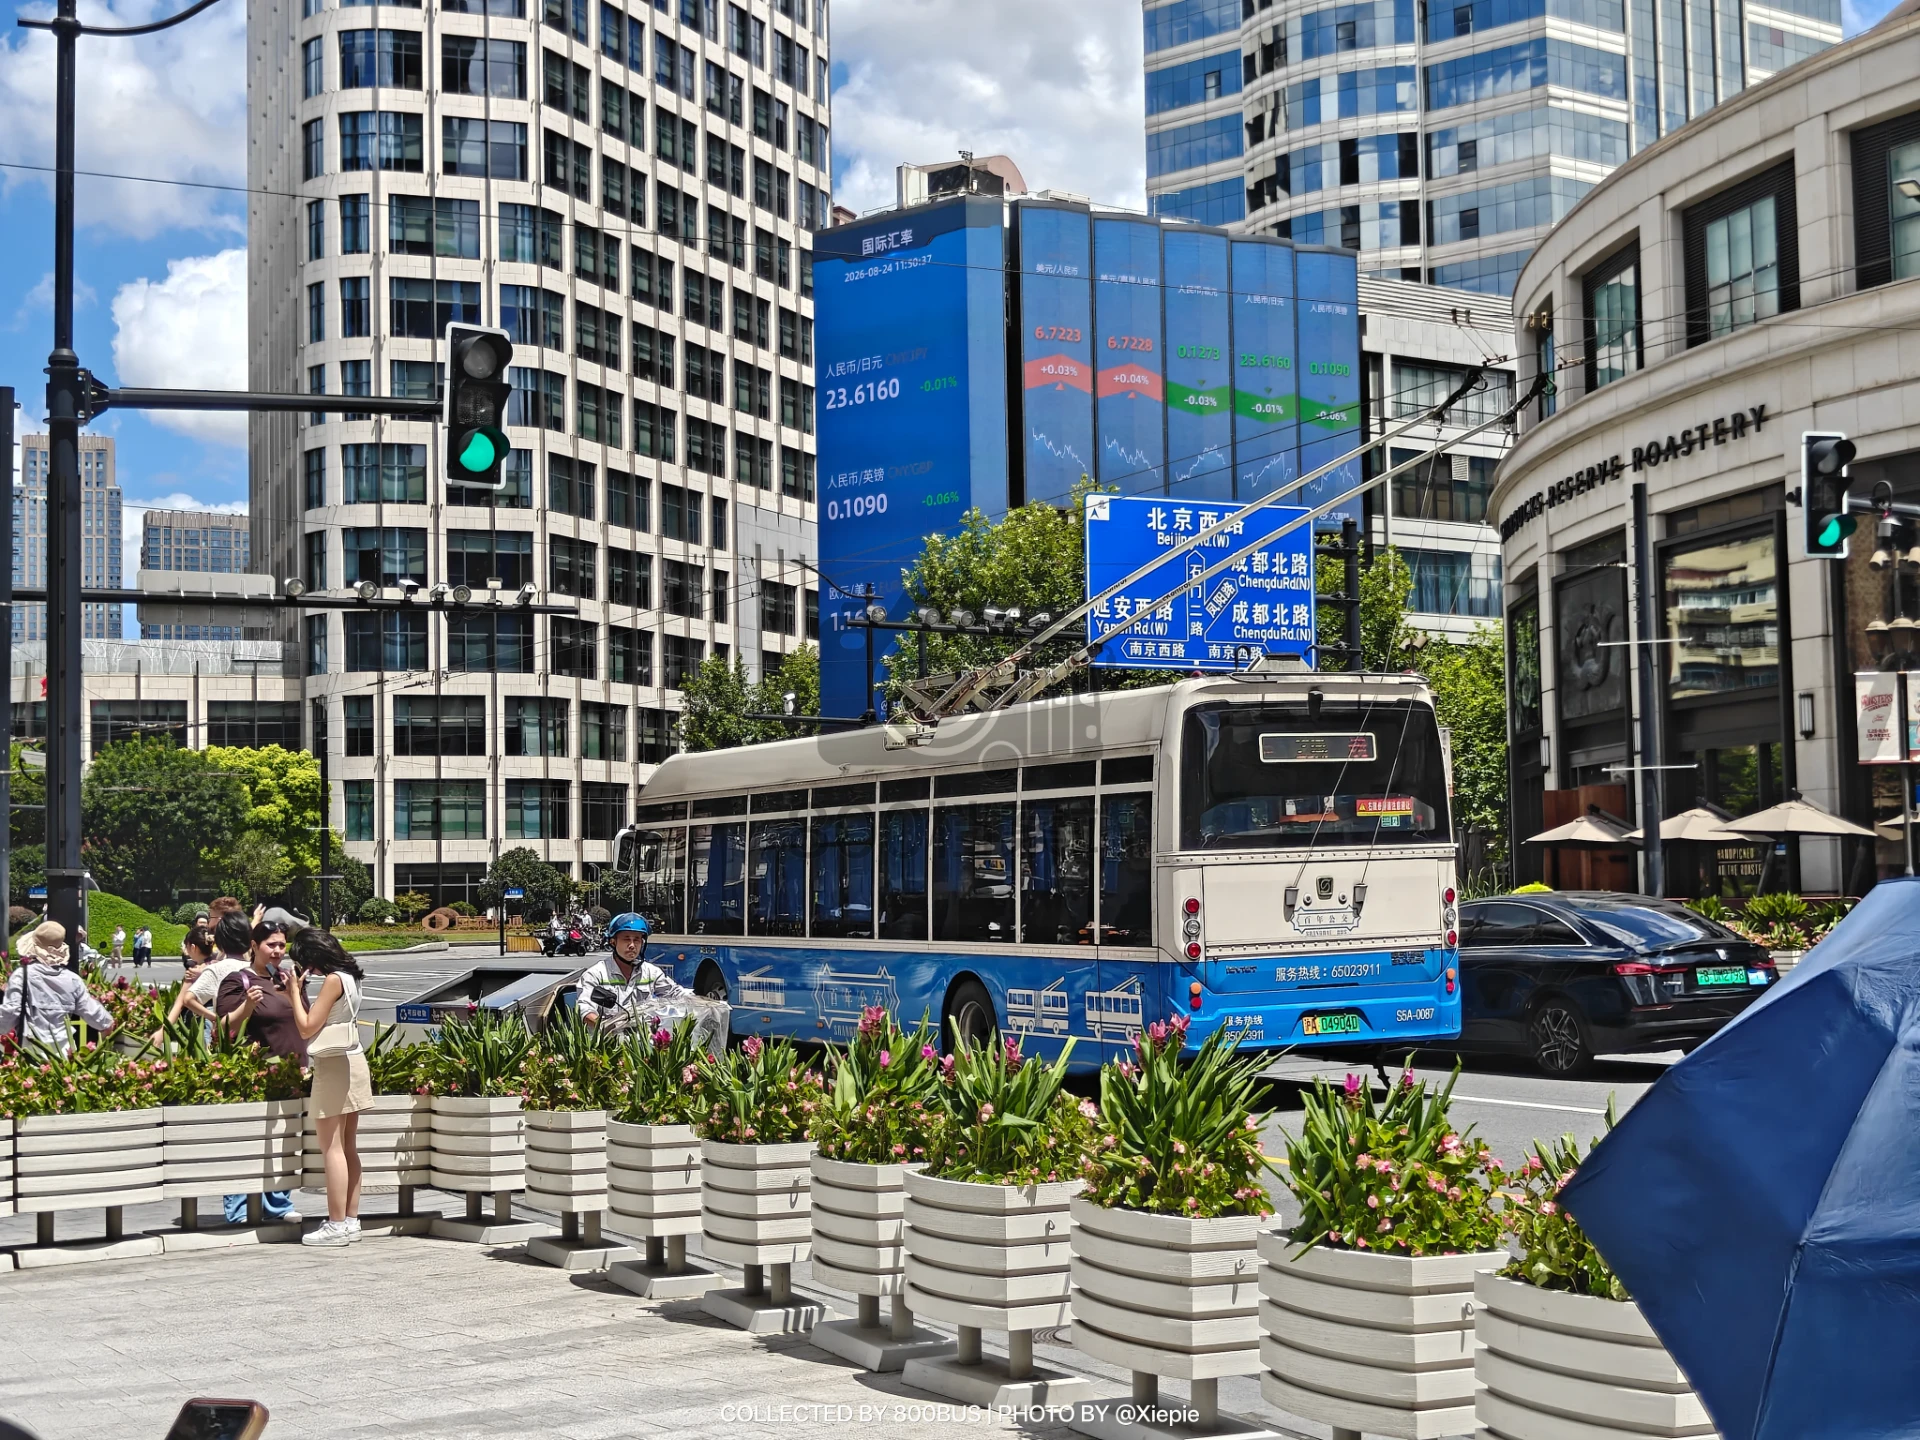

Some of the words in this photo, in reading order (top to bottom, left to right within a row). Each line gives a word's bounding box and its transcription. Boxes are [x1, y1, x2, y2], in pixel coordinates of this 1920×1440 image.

[862, 228, 914, 256] 国际汇率
[844, 265, 893, 283] 2026-08-24
[895, 254, 932, 272] 11:50:37
[1035, 263, 1079, 276] 美元/人民币
[1034, 326, 1082, 343] 6.7223
[1107, 336, 1153, 353] 6.7228
[1176, 345, 1221, 361] 0.1273
[825, 355, 883, 379] 人民币/日元
[1239, 353, 1291, 370] 23.6160
[1309, 361, 1350, 377] 0.1090
[1040, 364, 1078, 377] +0.03%
[1113, 373, 1149, 386] +0.04%
[826, 378, 900, 410] 23.6160
[919, 375, 958, 392] -0.01%
[1183, 395, 1217, 408] -0.03%
[1251, 403, 1284, 415] -0.01%
[1315, 410, 1348, 423] -0.06%
[1547, 455, 1620, 509] RESERVE
[1632, 404, 1766, 473] ROASTERY
[827, 467, 885, 490] 人民币/英镑
[827, 493, 888, 520] 0.1090
[921, 490, 959, 507] -0.06%
[1146, 507, 1246, 535] 北京西路
[1231, 551, 1309, 577] 成都北路
[1189, 564, 1204, 637] 石门二路
[1205, 581, 1237, 618] 凤阳路
[1092, 595, 1174, 622] 延安西路
[1232, 600, 1311, 627] 成都北路
[1134, 621, 1168, 636] Rd.(W)
[1129, 641, 1186, 658] 南京西路
[1207, 643, 1264, 660] 南京西路
[1740, 864, 1762, 876] ROASTE
[1224, 1015, 1264, 1027] 服务热线
[1396, 1008, 1435, 1022] S5A-0087
